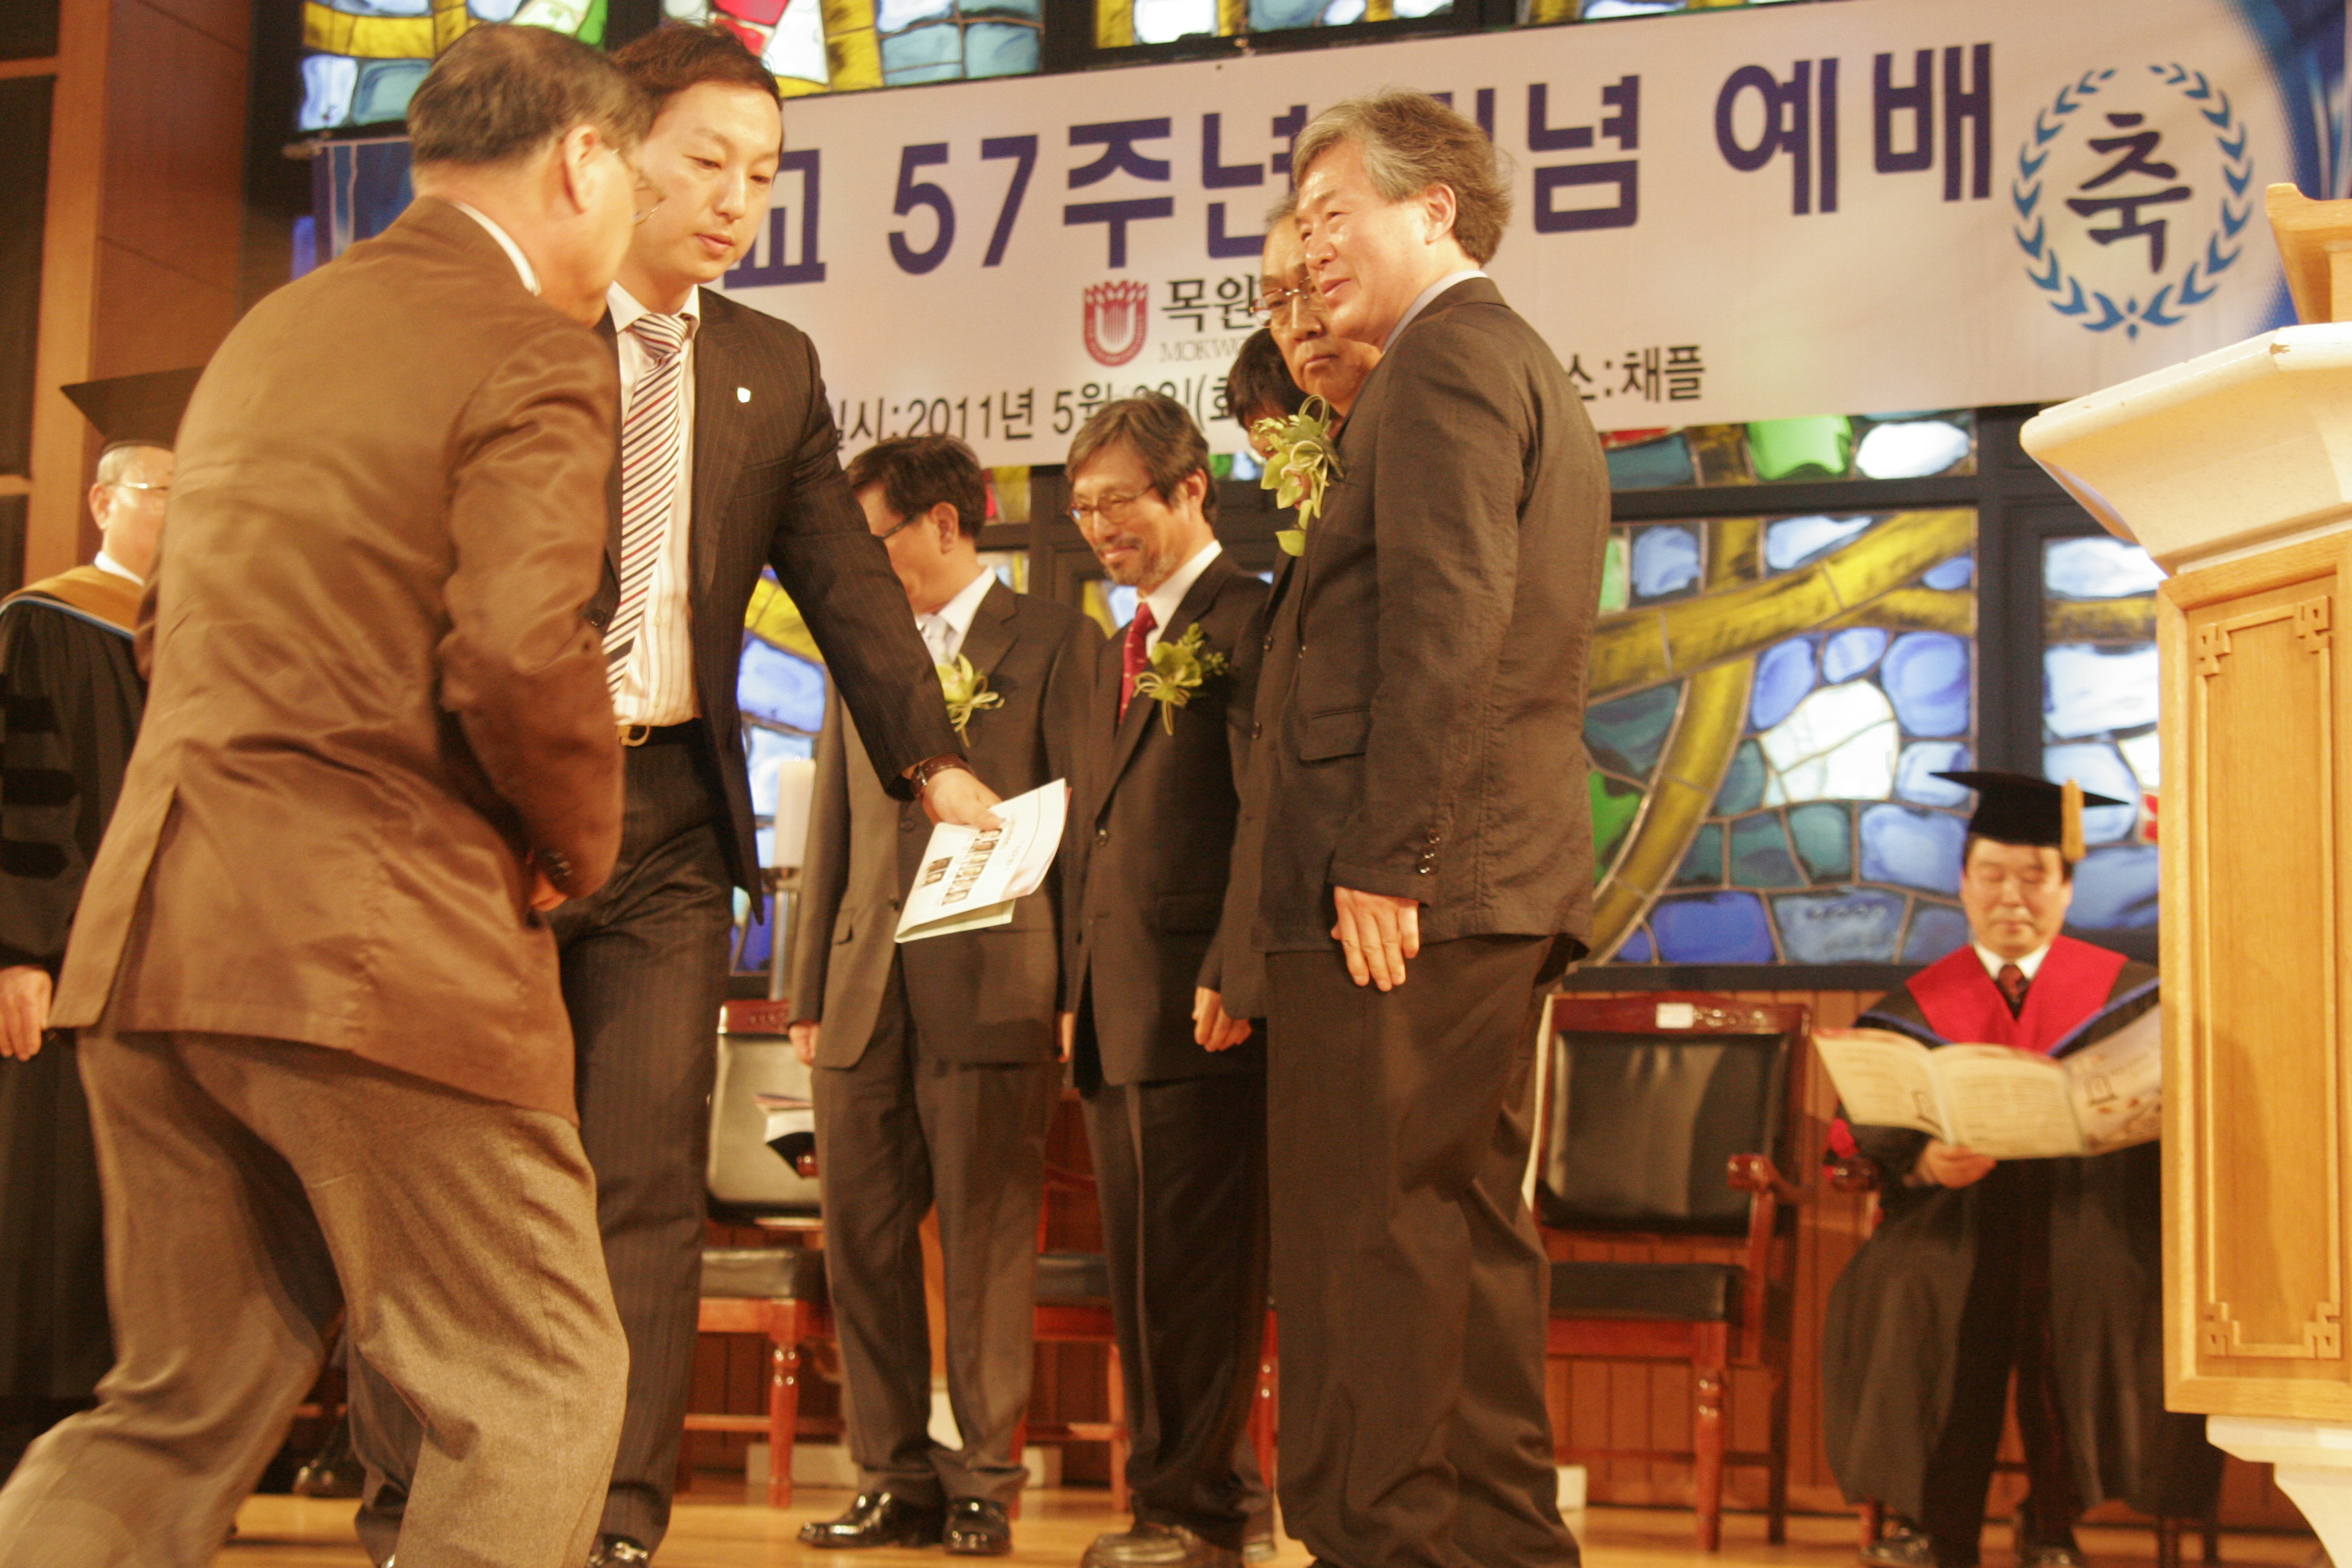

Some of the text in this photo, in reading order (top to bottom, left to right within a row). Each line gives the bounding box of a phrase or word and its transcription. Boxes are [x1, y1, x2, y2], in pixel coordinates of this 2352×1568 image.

[888, 103, 1308, 275] 57주년
[1715, 42, 1992, 215] 예배
[2066, 113, 2192, 274] 축
